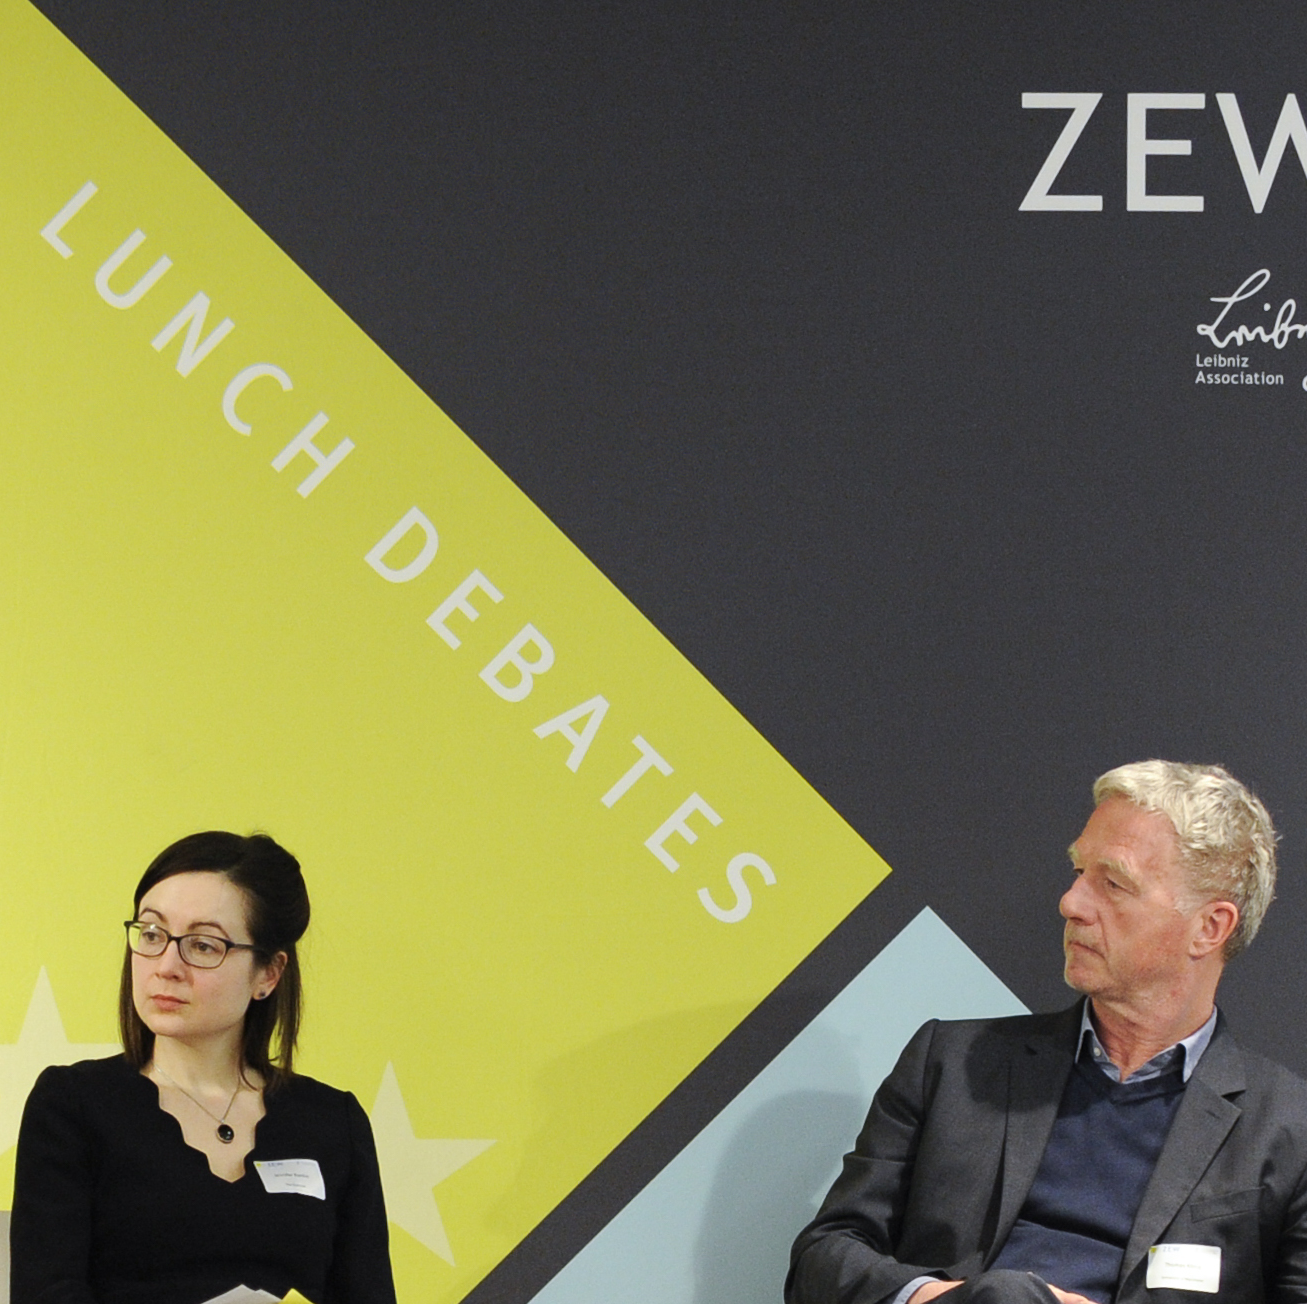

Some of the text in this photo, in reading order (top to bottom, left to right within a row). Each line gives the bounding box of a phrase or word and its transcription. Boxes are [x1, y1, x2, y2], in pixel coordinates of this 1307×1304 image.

[1195, 353, 1249, 368] Leibniz
[1195, 370, 1284, 385] Association
[39, 180, 777, 924] LUNCH DEBATES
